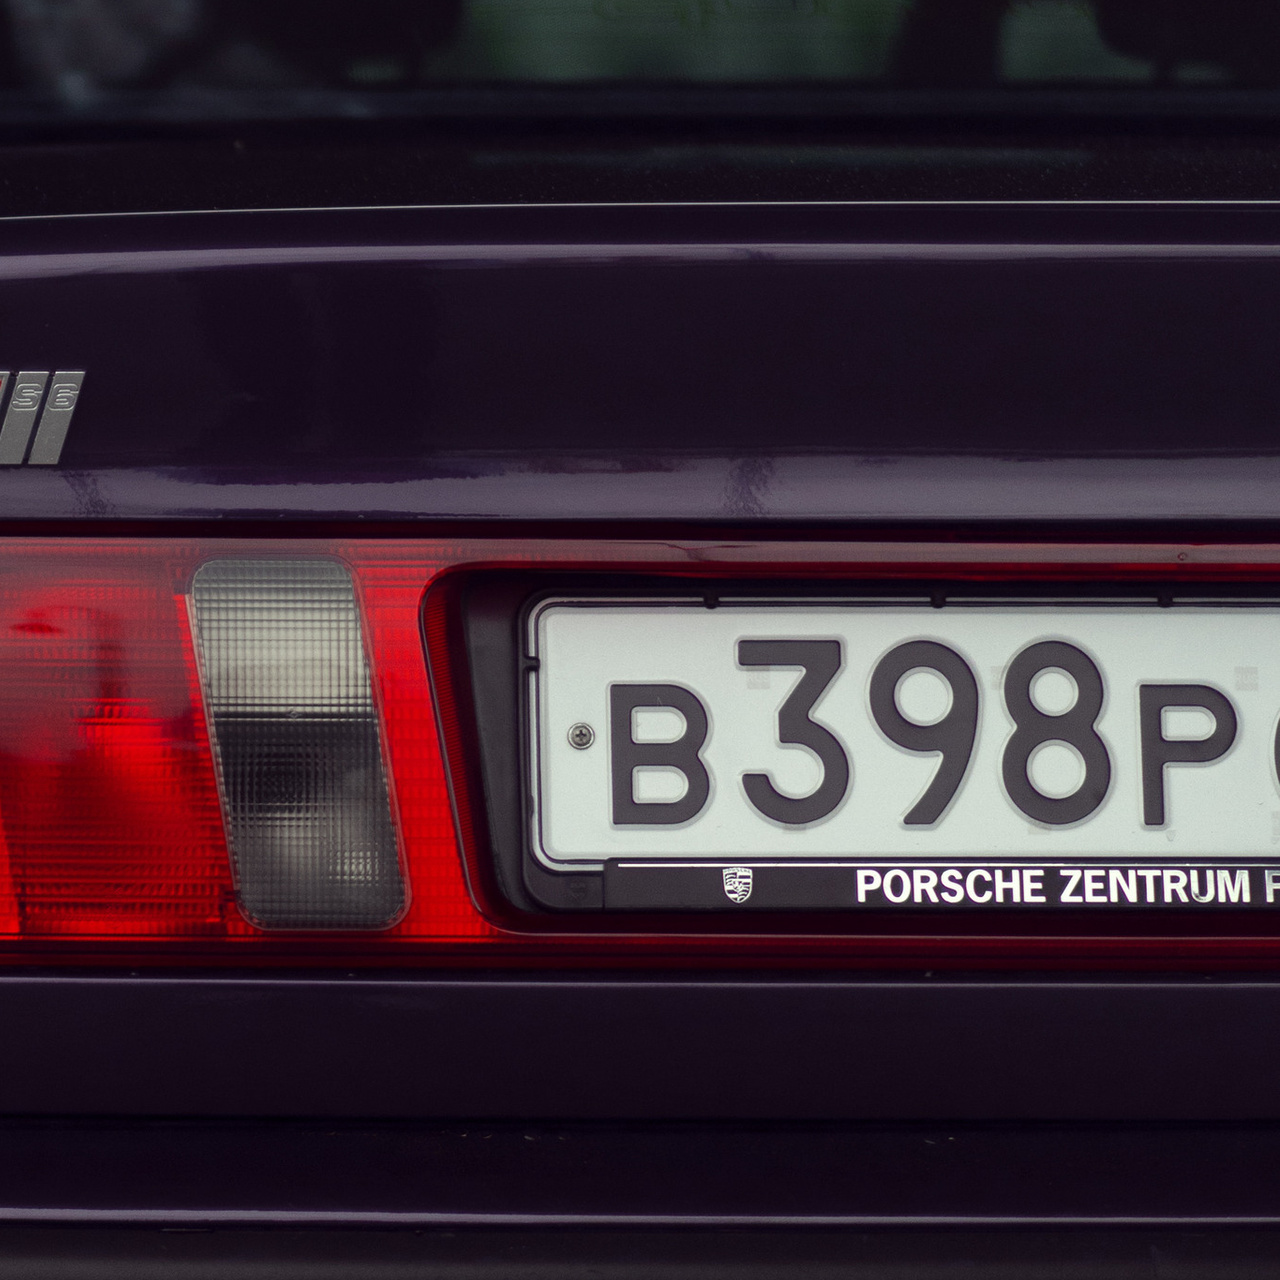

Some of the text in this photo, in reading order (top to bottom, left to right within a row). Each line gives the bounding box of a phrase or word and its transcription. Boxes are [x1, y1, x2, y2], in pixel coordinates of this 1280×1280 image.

[609, 639, 1280, 826] B398P
[856, 868, 1047, 904] PORSCHE
[1059, 868, 1252, 904] ZENTRUM
